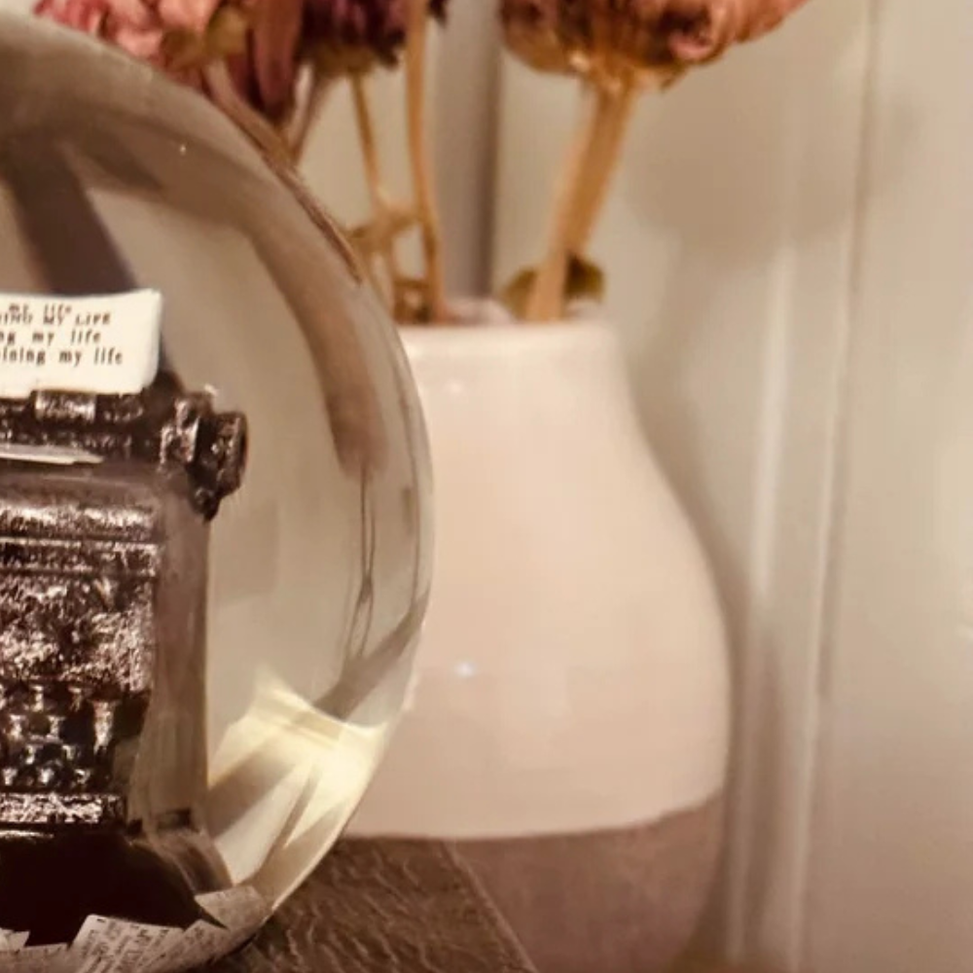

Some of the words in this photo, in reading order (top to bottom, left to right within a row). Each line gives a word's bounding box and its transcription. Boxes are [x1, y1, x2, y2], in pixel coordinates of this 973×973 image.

[32, 331, 55, 346] my
[71, 328, 102, 345] life
[59, 350, 83, 368] my
[93, 347, 123, 366] life
